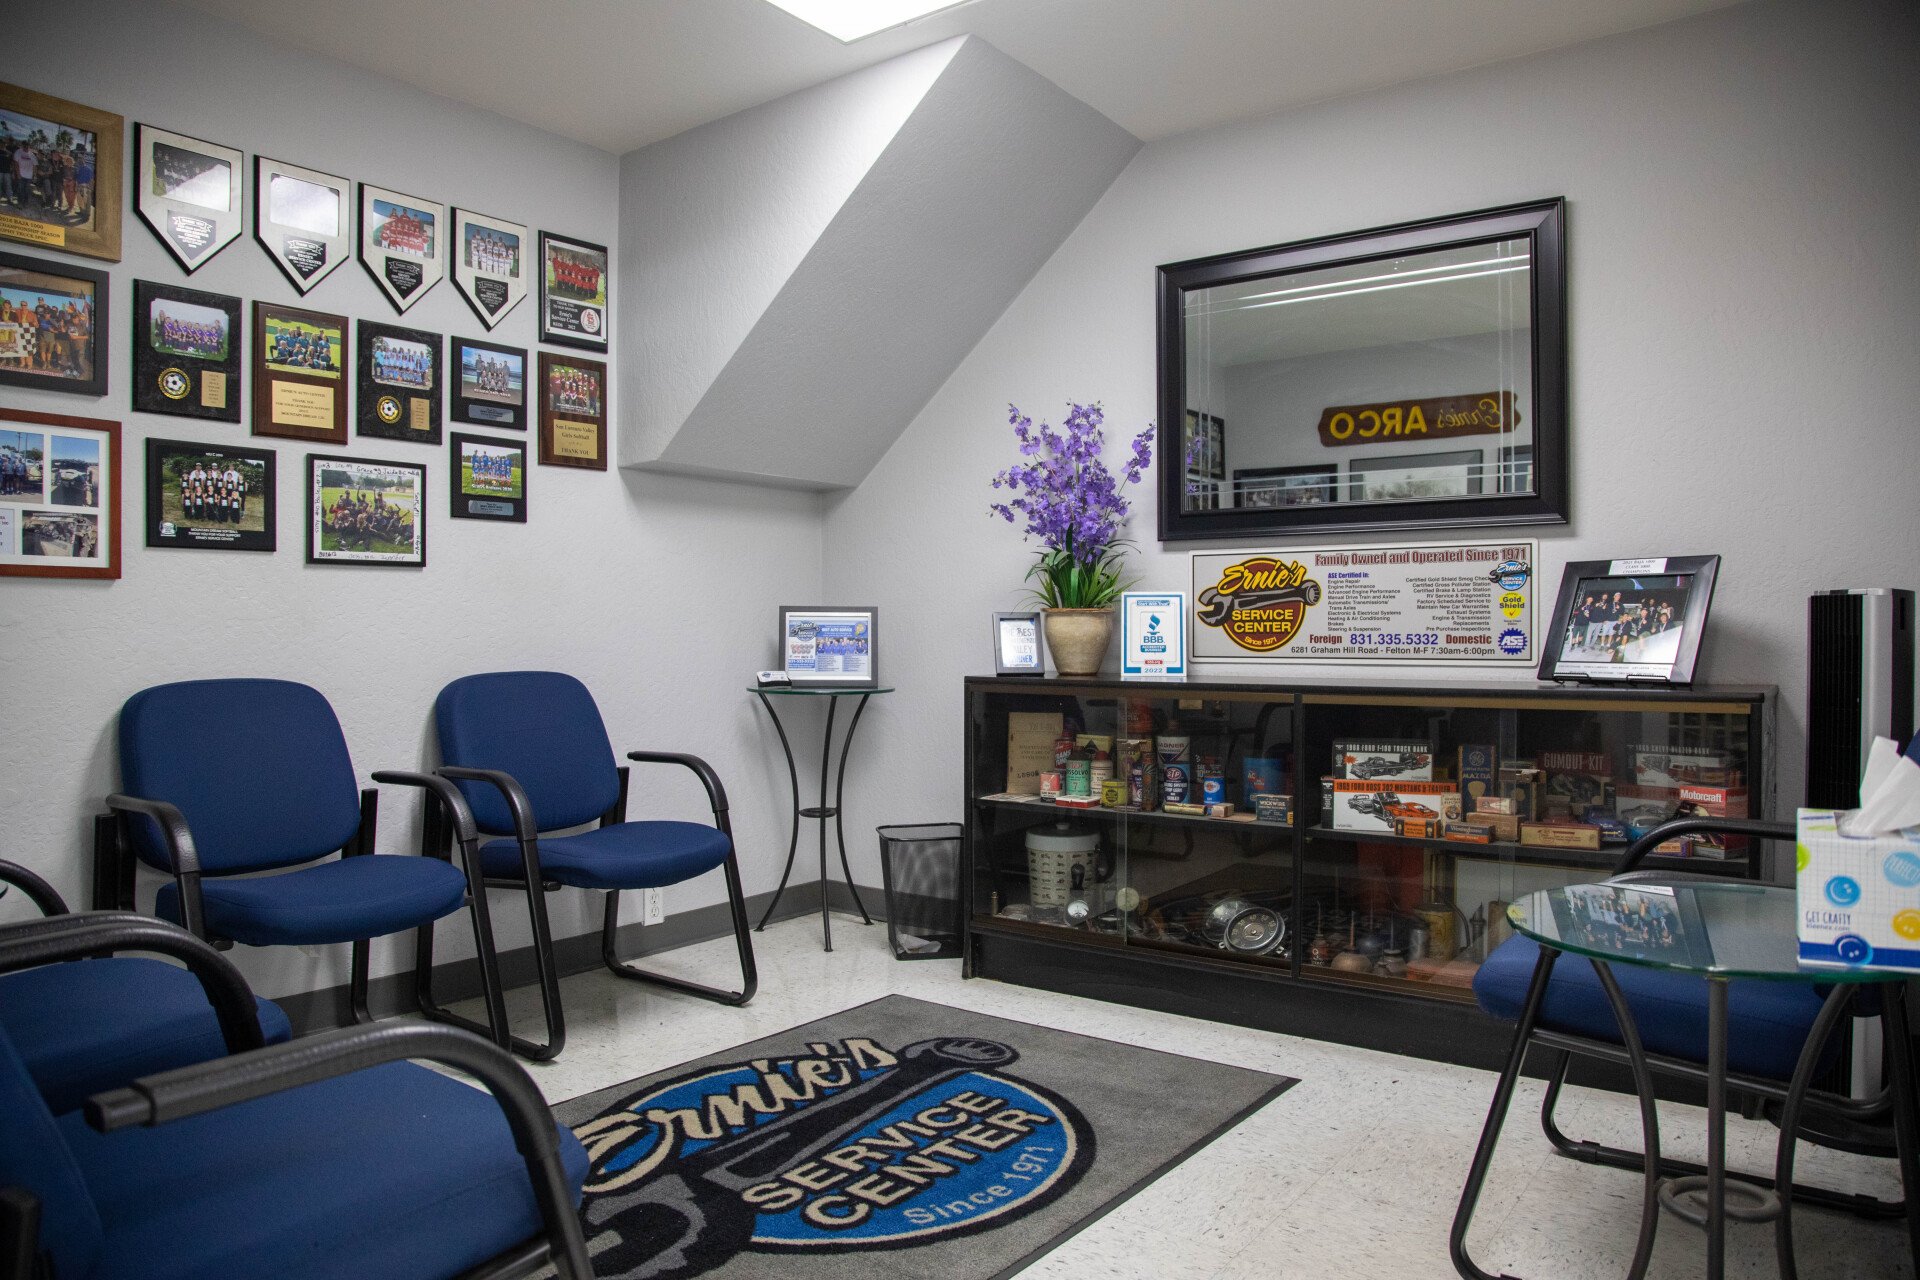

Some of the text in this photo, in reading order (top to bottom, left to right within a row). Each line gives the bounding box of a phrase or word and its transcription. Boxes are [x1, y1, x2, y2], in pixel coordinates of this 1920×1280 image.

[1315, 546, 1526, 567] Family Owned and Operated Since 1971
[1497, 562, 1528, 572] Ernie's
[1217, 560, 1307, 595] Ernie's
[1232, 609, 1294, 621] SERVICE
[1017, 628, 1035, 637] BEST
[1234, 622, 1292, 633] CENTER
[1244, 636, 1277, 645] Since 1971
[1309, 634, 1492, 645] Foreign 831.335.5332 Domestic
[1501, 635, 1524, 646] ASE
[1431, 647, 1495, 656] 7:30am-6:00pm
[1544, 752, 1604, 770] GUMOUT KIT
[1167, 769, 1181, 779] STP
[1351, 783, 1365, 791] FORD
[1680, 789, 1722, 802] Motorcraft
[1450, 826, 1483, 834] Westinghouse
[1806, 911, 1851, 925] GET CRAFTY
[572, 1037, 899, 1194] Ernie's
[742, 1091, 1006, 1210] SERVICE
[804, 1107, 1051, 1226] CENTER
[902, 1146, 1055, 1224] Since 1971
